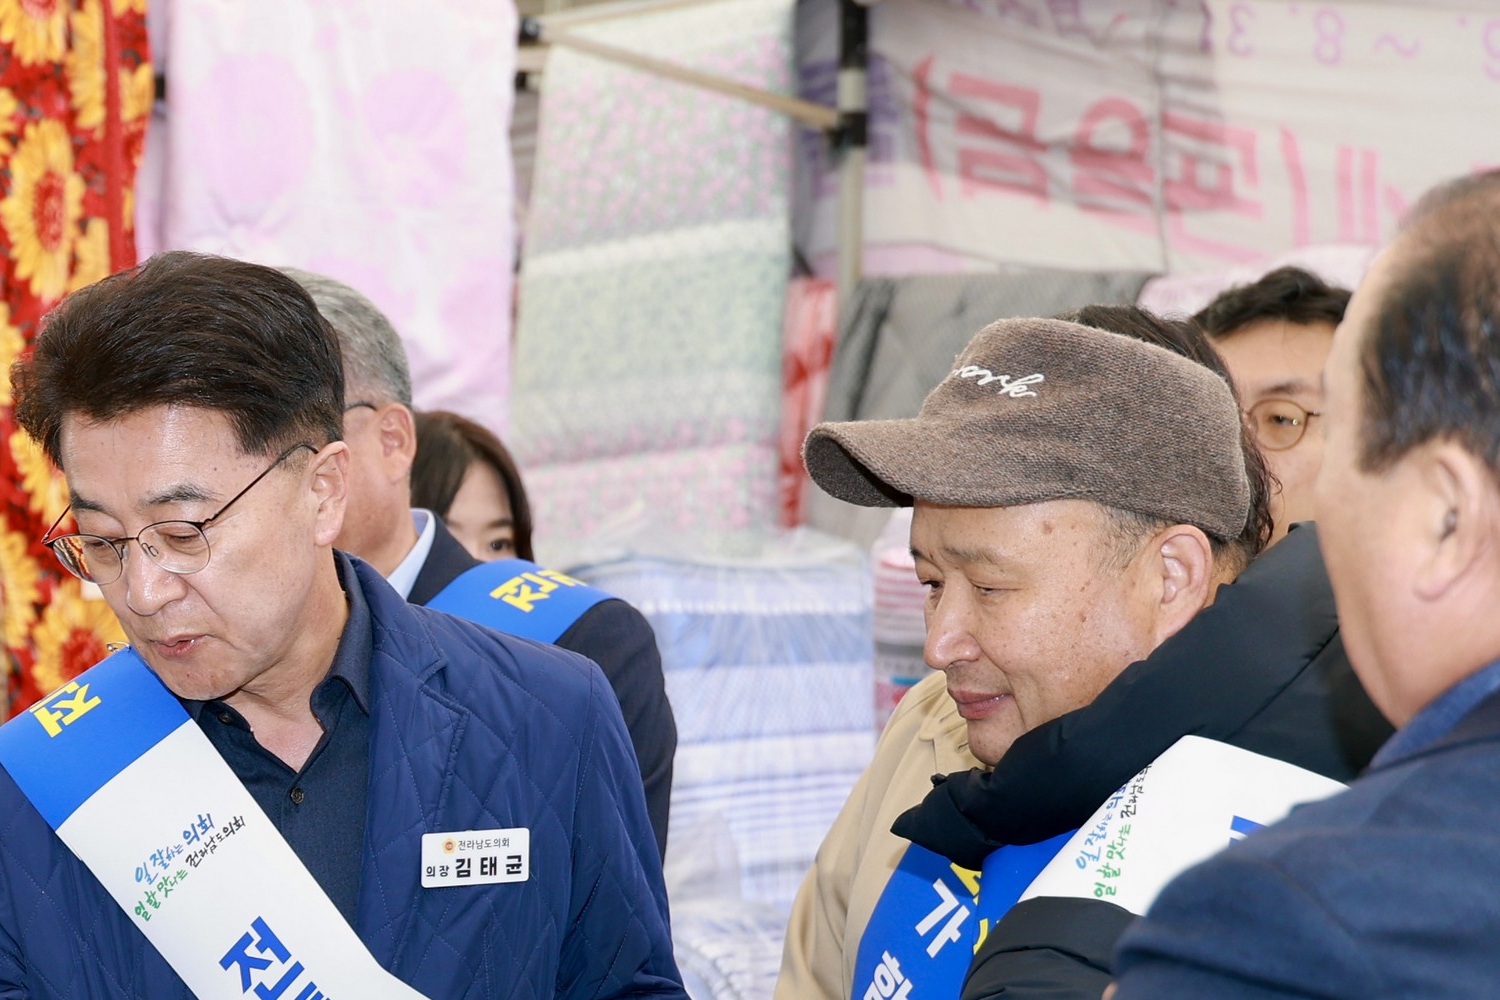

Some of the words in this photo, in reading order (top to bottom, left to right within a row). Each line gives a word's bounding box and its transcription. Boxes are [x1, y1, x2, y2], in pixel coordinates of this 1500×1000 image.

[953, 364, 1045, 398] ork
[182, 813, 215, 845] 의회
[185, 815, 246, 868] 전라남도의회
[458, 837, 510, 851] 전라남도의회
[915, 862, 982, 958] 가
